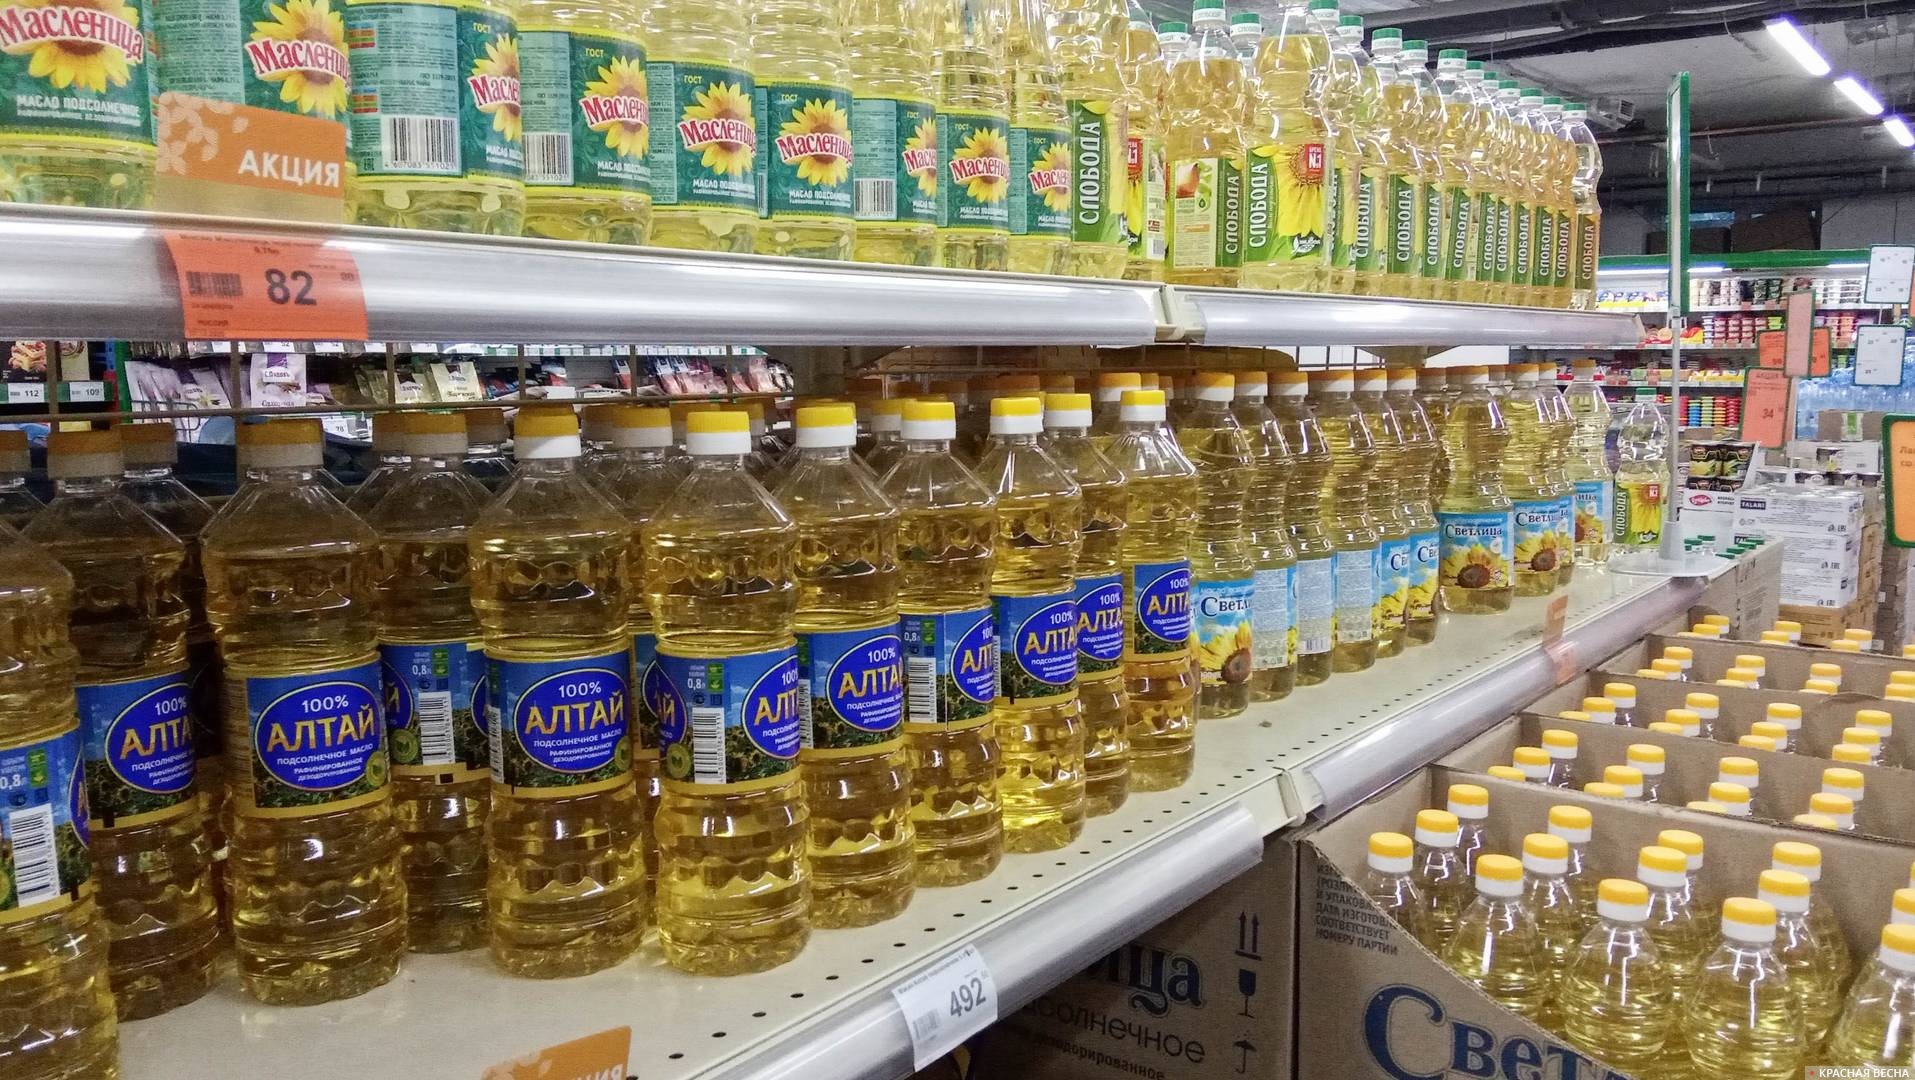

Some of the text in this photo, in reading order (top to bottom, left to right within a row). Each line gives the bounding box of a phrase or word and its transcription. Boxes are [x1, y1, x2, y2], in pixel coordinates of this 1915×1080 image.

[0, 8, 143, 60] Масленица
[586, 47, 604, 58] ГОСТ
[470, 75, 520, 106] Масле
[684, 75, 702, 84] ГОСТ
[16, 95, 141, 117] МАСЛО ПОДСОЛНЕЧНОЕ
[582, 96, 647, 126] Маслен
[781, 94, 799, 102] ГОСТ
[238, 150, 340, 187] АКЦИЯ
[904, 149, 937, 173] Масле
[1080, 122, 1101, 224] СЛОБОДА
[693, 179, 718, 189] МАСЛО
[789, 190, 813, 199] МАСЛО
[1226, 175, 1240, 254] СЛОБОДА
[1250, 162, 1267, 248] СЛОБОДА
[1356, 183, 1371, 257] СЛОБОДА
[1396, 190, 1411, 261] СЛОБОДА
[1427, 196, 1440, 265] СЛОБОДА
[1454, 201, 1469, 267] СЛОБОДА
[1484, 205, 1495, 270] СЛОБОДА
[1497, 210, 1509, 271] СЛОБОДА
[1518, 214, 1529, 273] СЛОБОДА
[1540, 218, 1551, 275] СЛОБОДА
[1557, 222, 1569, 277] СЛОБОДА
[1582, 225, 1594, 279] СЛОБОДА
[265, 268, 317, 306] 82
[1763, 408, 1774, 419] 34
[1616, 491, 1627, 536] СЛОБОДА
[1445, 523, 1502, 539] Светлица
[1100, 592, 1120, 605] 100%
[1146, 591, 1190, 616] АЛТА
[1050, 610, 1073, 625] 100%
[1077, 606, 1123, 635] АЛТА
[868, 646, 896, 664] 100%
[1024, 626, 1076, 656] АЛТА
[558, 681, 601, 698] 100%
[838, 664, 902, 700] АЛТА
[155, 696, 187, 716] 100%
[302, 695, 349, 714] 100%
[525, 690, 623, 735] АЛТАЙ
[754, 688, 798, 727] АЛТ
[119, 718, 192, 760] АЛТА
[267, 703, 375, 753] АЛТАЙ
[534, 727, 622, 748] ПОДСОЛНЕЧНОЕ МАСЛО
[277, 743, 374, 765] ПОДСОЛНЕЧНОЕ МАСЛО
[550, 741, 613, 757] РАФИНИРОВАННОЕ
[1316, 902, 1339, 915] ДАТА
[1315, 928, 1397, 956] НОМЕРУ ПАРТИИ
[1316, 914, 1390, 940] СООТВЕТСТВУЕТ
[950, 977, 986, 1016] 492
[1038, 998, 1206, 1064] солнечное
